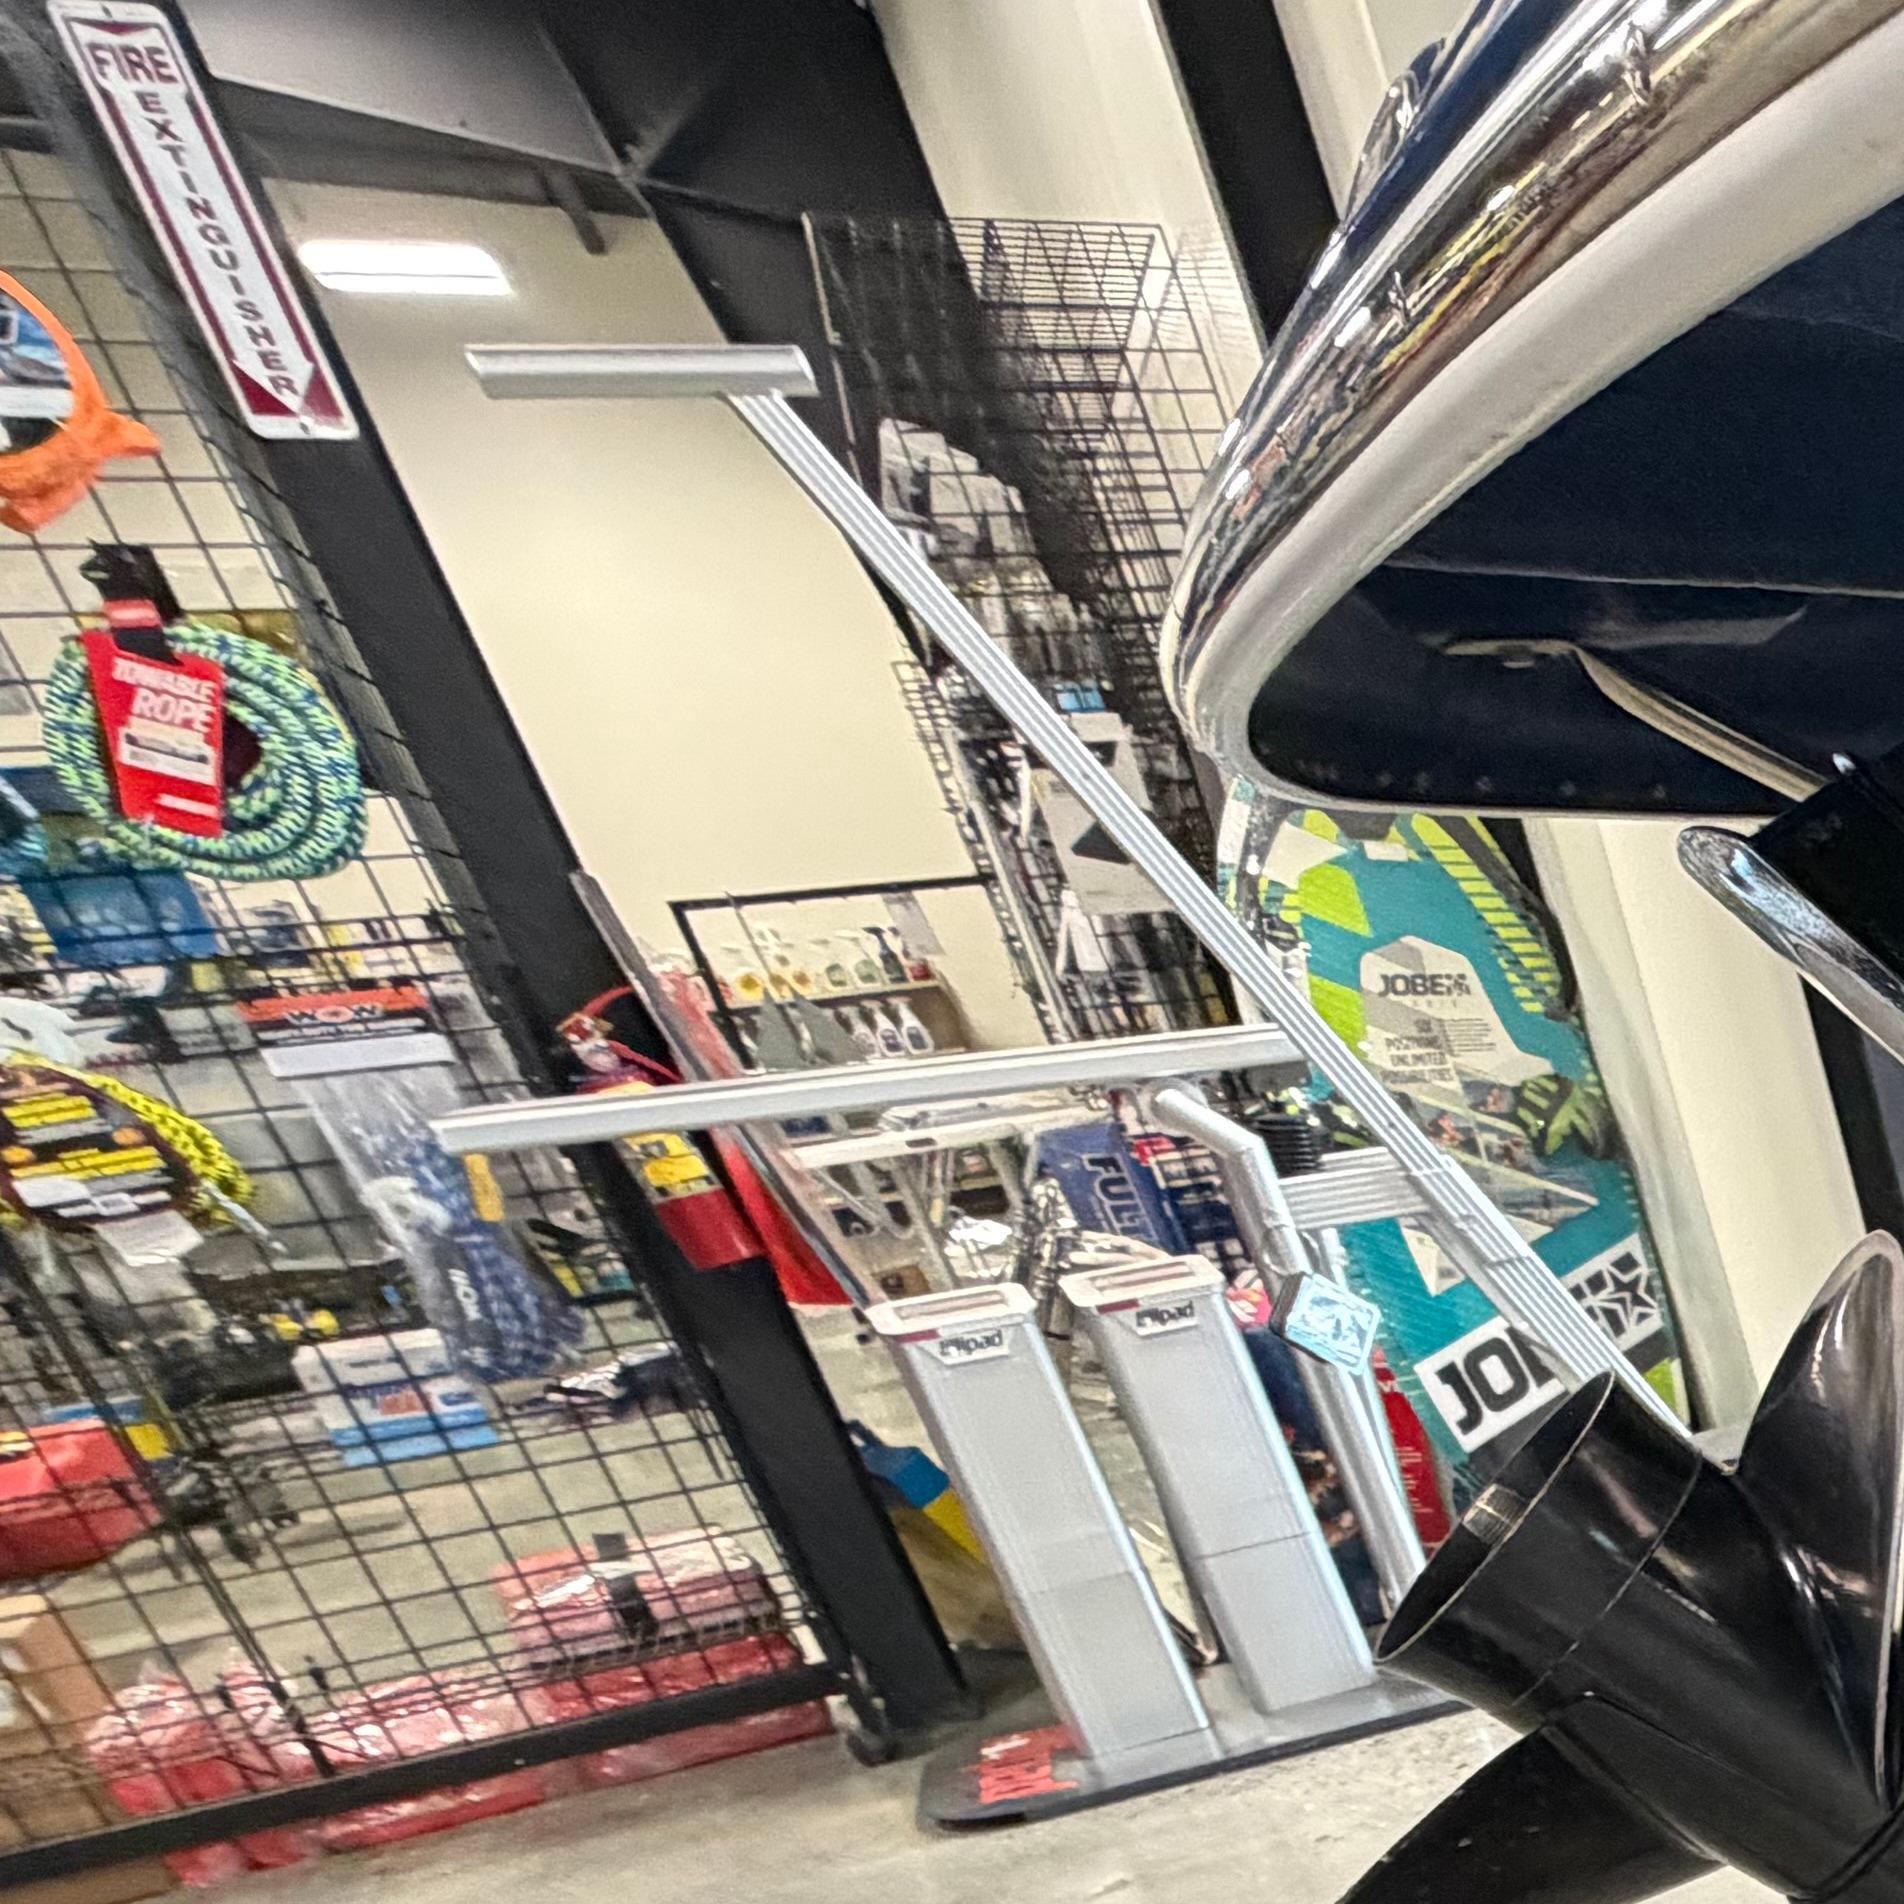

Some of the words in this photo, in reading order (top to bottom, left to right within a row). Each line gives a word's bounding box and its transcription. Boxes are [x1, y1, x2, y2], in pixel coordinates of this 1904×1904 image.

[86, 43, 179, 85] FIRE
[135, 91, 299, 397] EXTINGUISHER
[131, 687, 217, 734] ROPE
[1377, 973, 1447, 997] JOBE
[1080, 1152, 1160, 1242] FULT
[1434, 1325, 1556, 1436] JO
